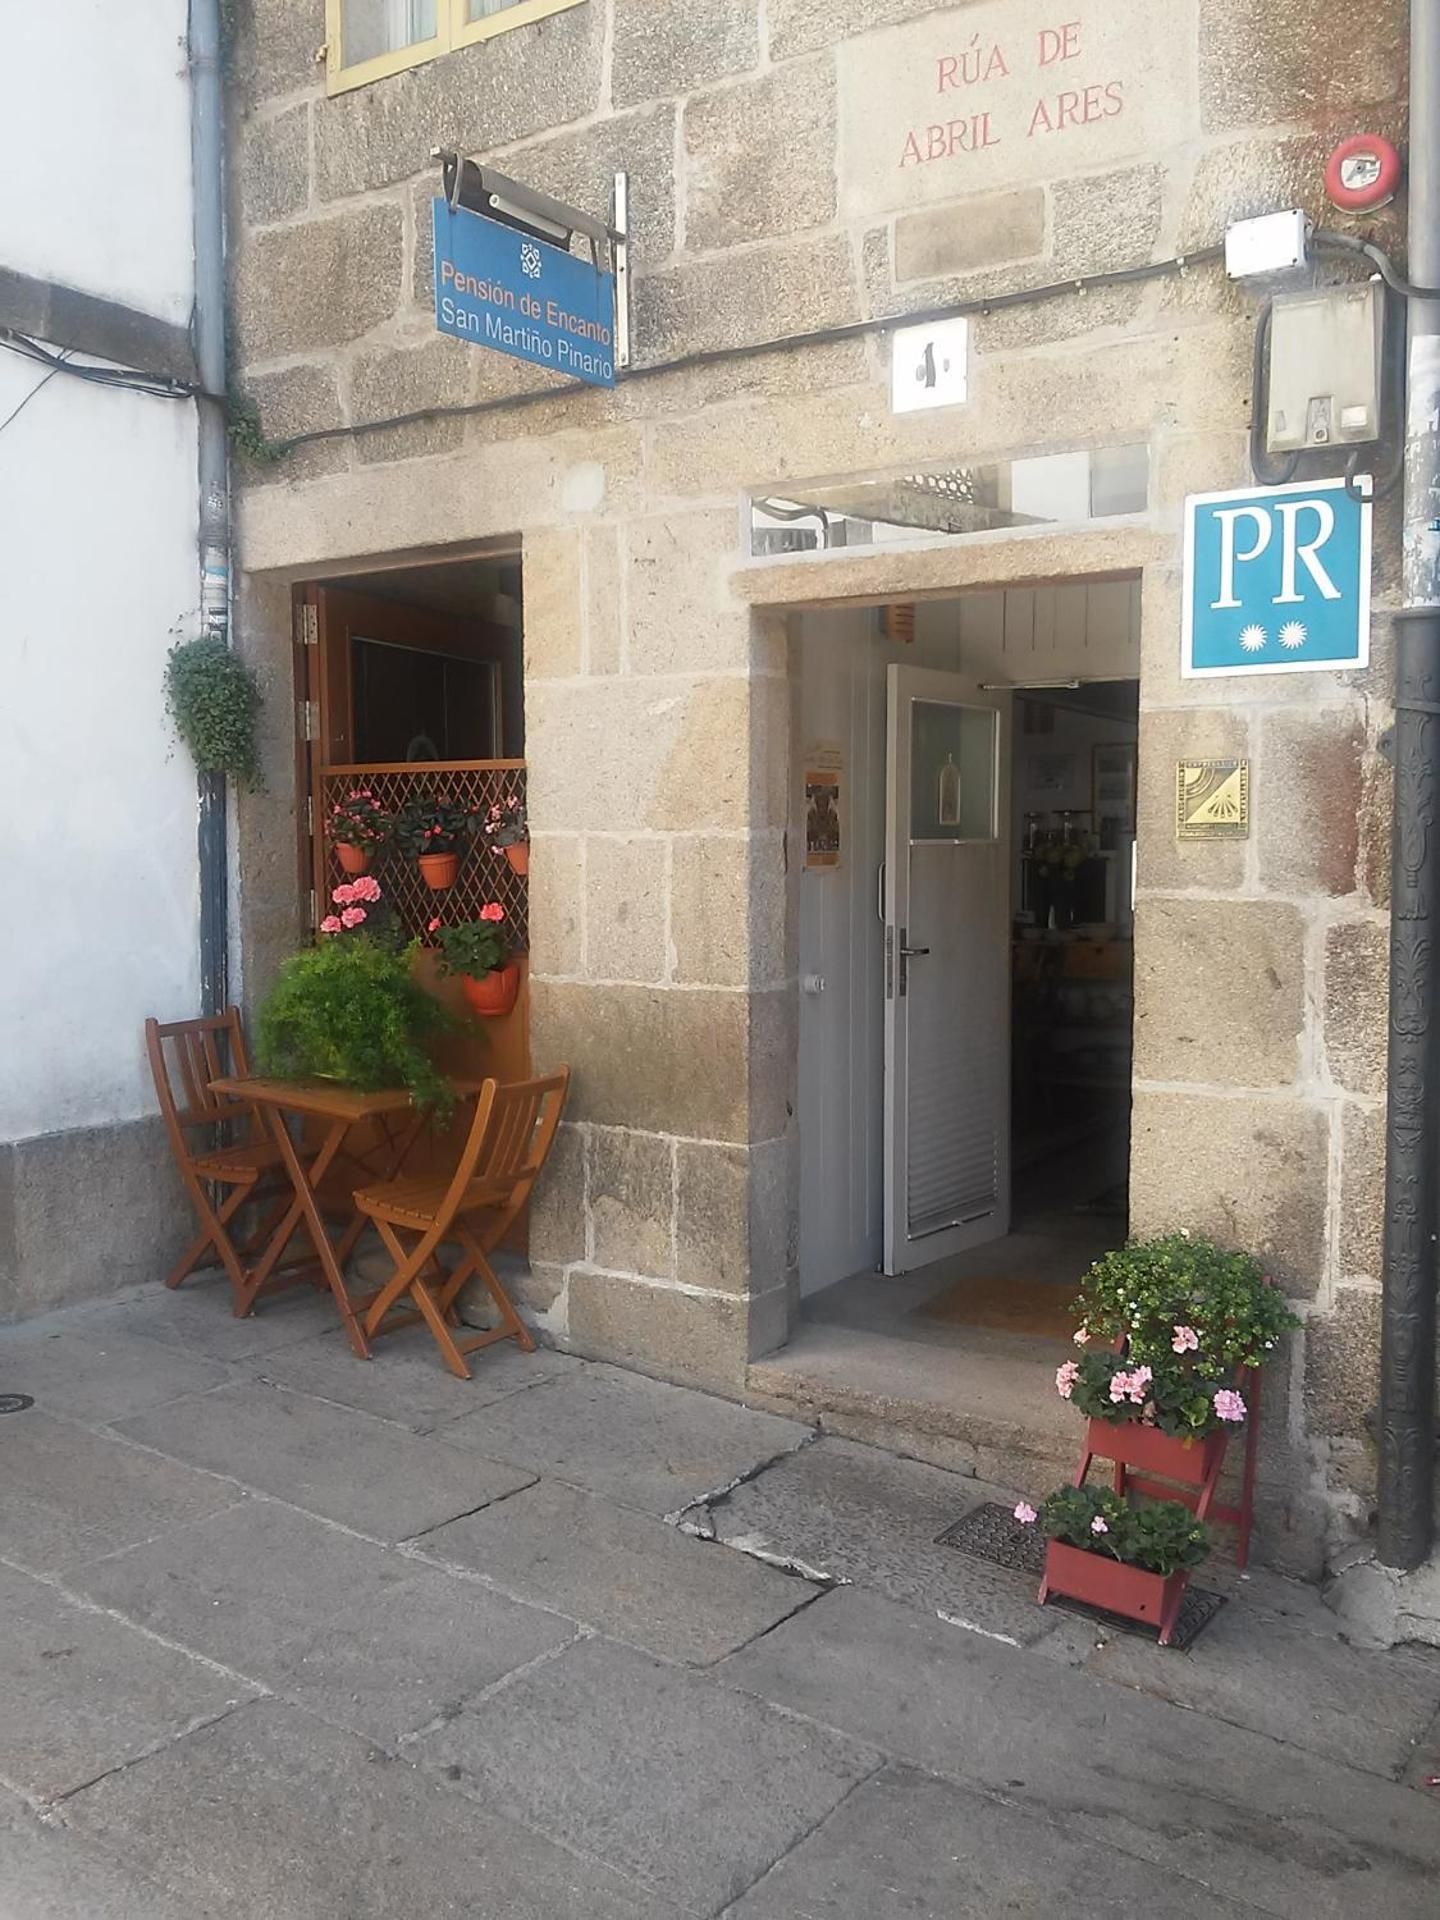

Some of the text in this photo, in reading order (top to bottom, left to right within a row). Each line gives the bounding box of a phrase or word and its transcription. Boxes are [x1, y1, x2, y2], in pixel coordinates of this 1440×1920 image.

[937, 21, 1083, 94] RÚA DE
[898, 81, 1124, 168] ABRIL ARES
[440, 260, 611, 346] Pensión de Encanto
[441, 298, 612, 380] San Martiño Pinario
[921, 341, 937, 389] 1
[1210, 499, 1342, 609] PR
